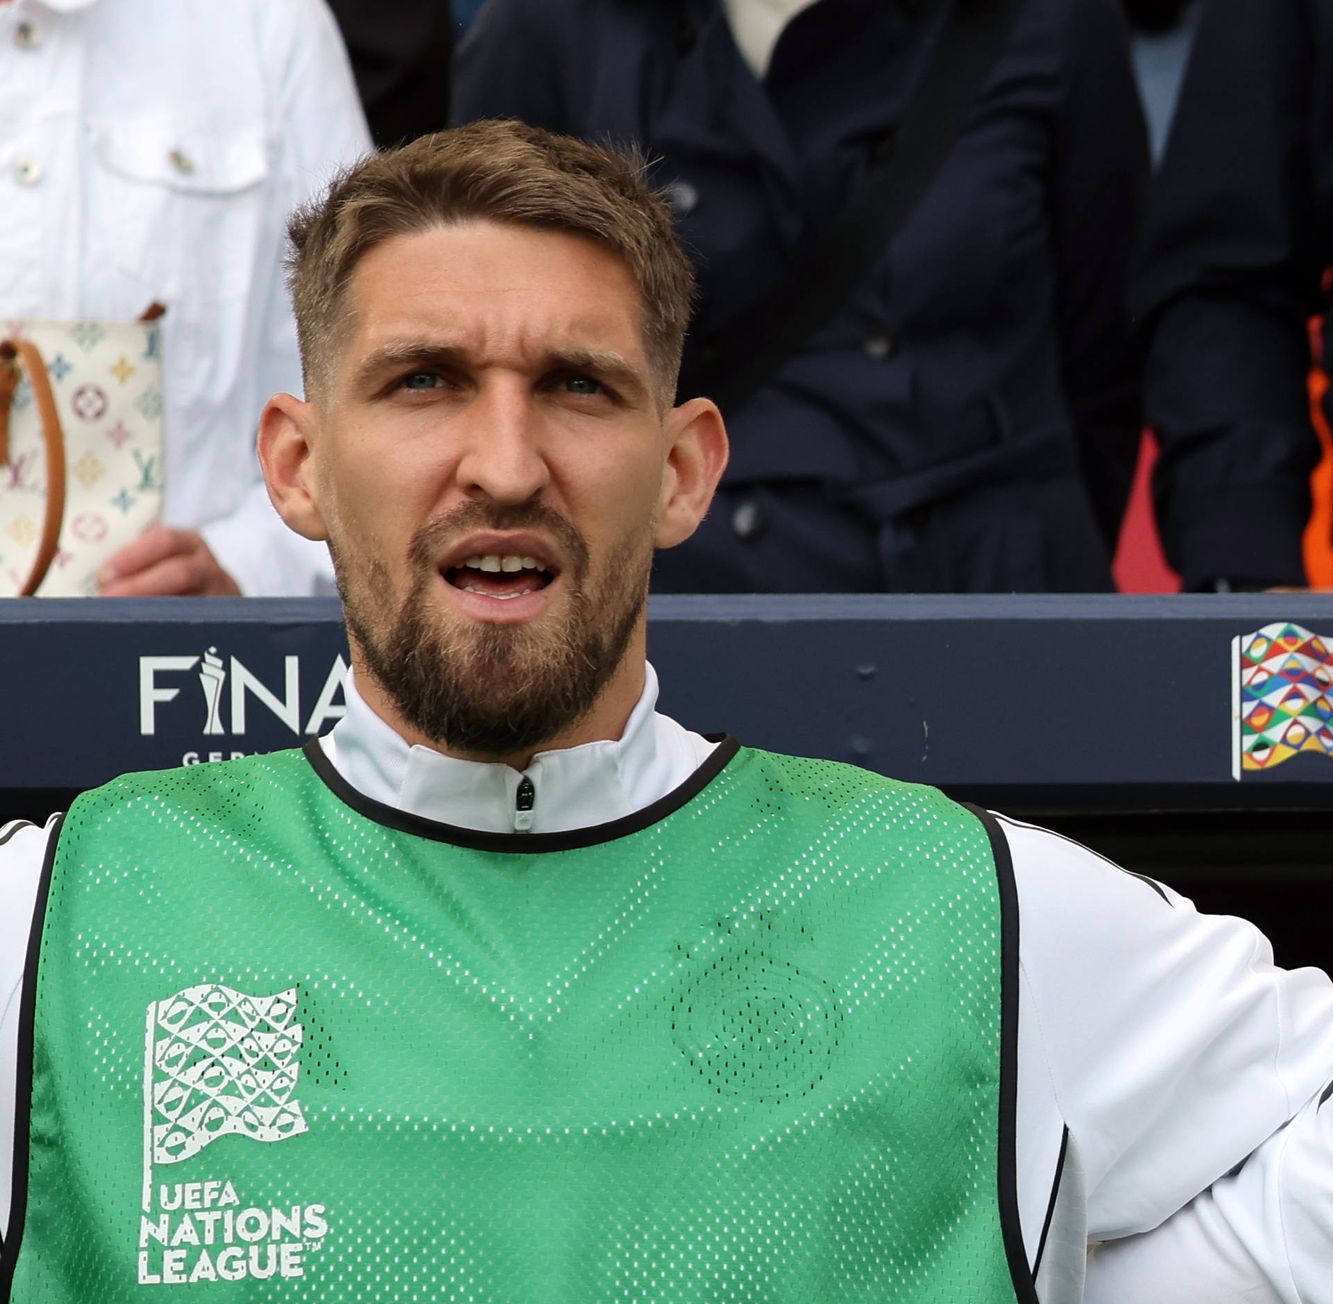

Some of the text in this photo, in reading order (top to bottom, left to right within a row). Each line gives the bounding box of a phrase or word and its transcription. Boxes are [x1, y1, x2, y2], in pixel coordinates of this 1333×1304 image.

[139, 646, 351, 737] FINA
[160, 1179, 240, 1211] UEFA
[139, 1204, 329, 1248] NATIONS
